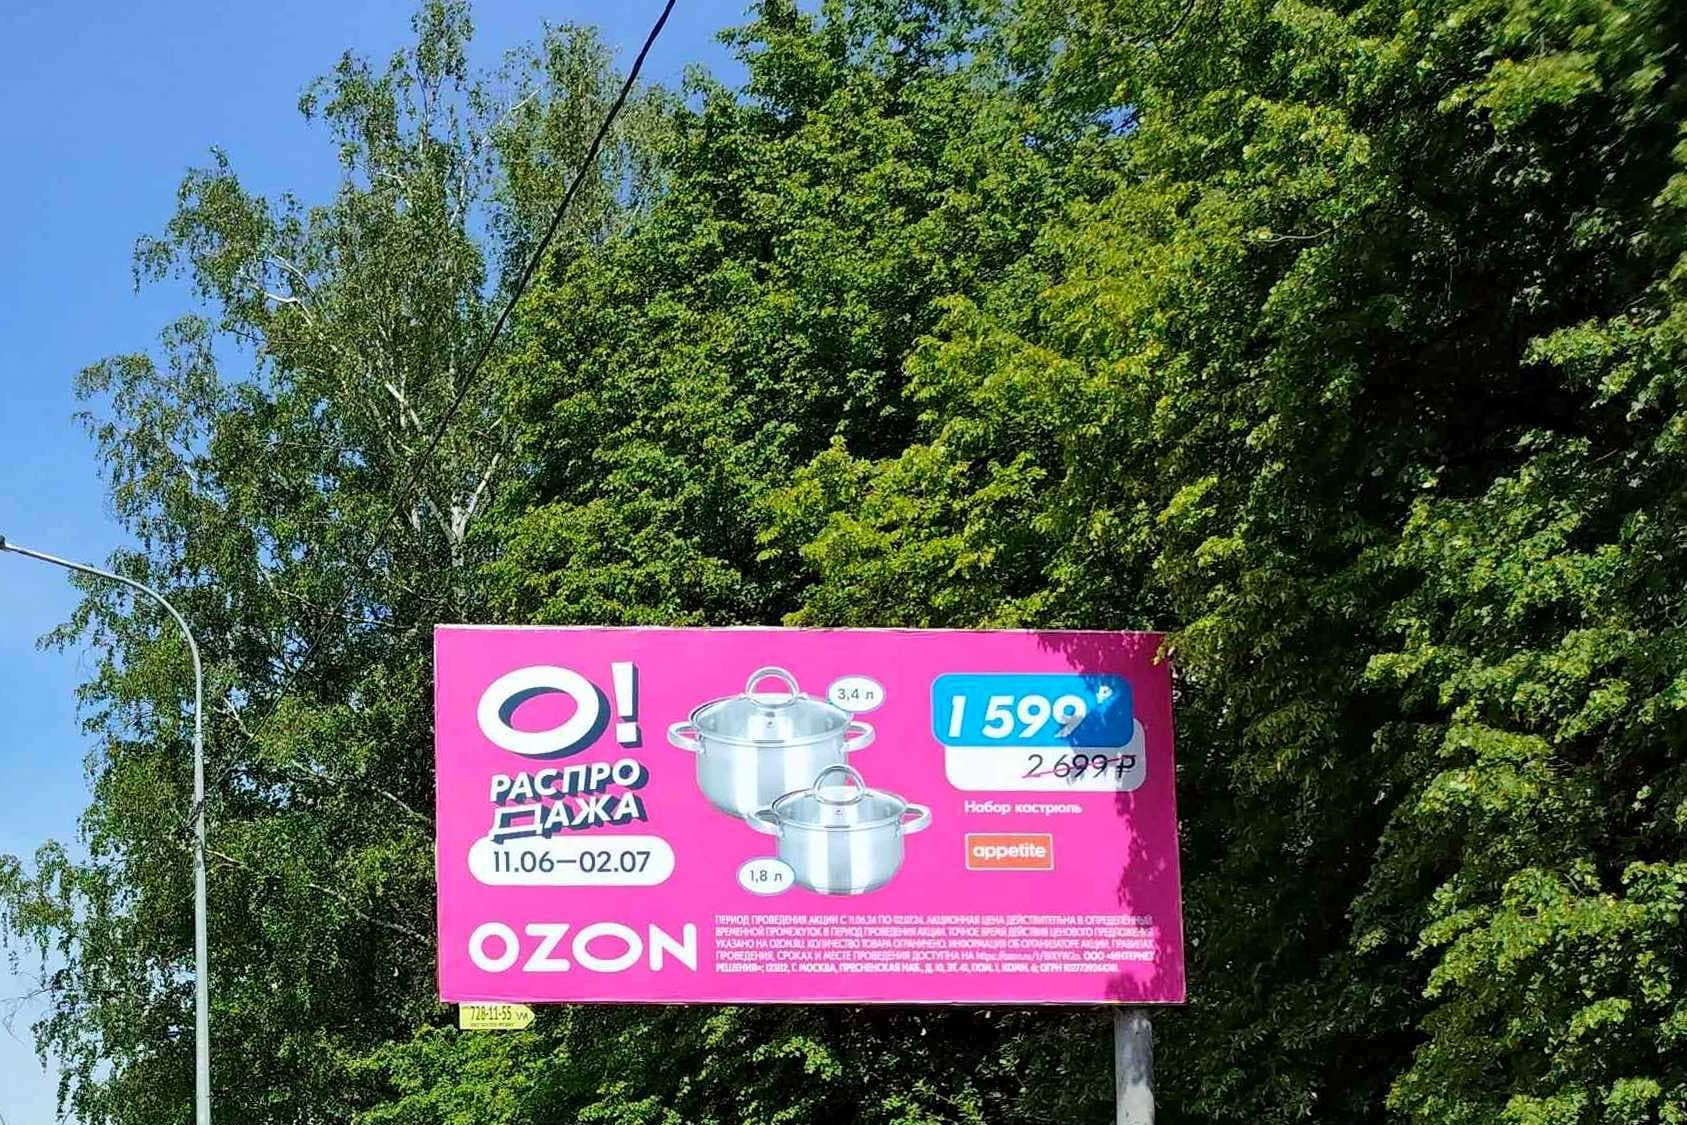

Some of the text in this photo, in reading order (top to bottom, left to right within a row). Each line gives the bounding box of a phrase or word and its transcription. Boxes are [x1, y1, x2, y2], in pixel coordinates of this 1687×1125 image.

[837, 688, 860, 701] 3,4
[489, 758, 649, 803] РАСПРО
[964, 801, 1083, 816] Набор кастрюль
[488, 791, 648, 845] ДАЖА
[972, 842, 1047, 860] appetite
[749, 869, 768, 883] 1,8
[468, 921, 698, 973] OZON
